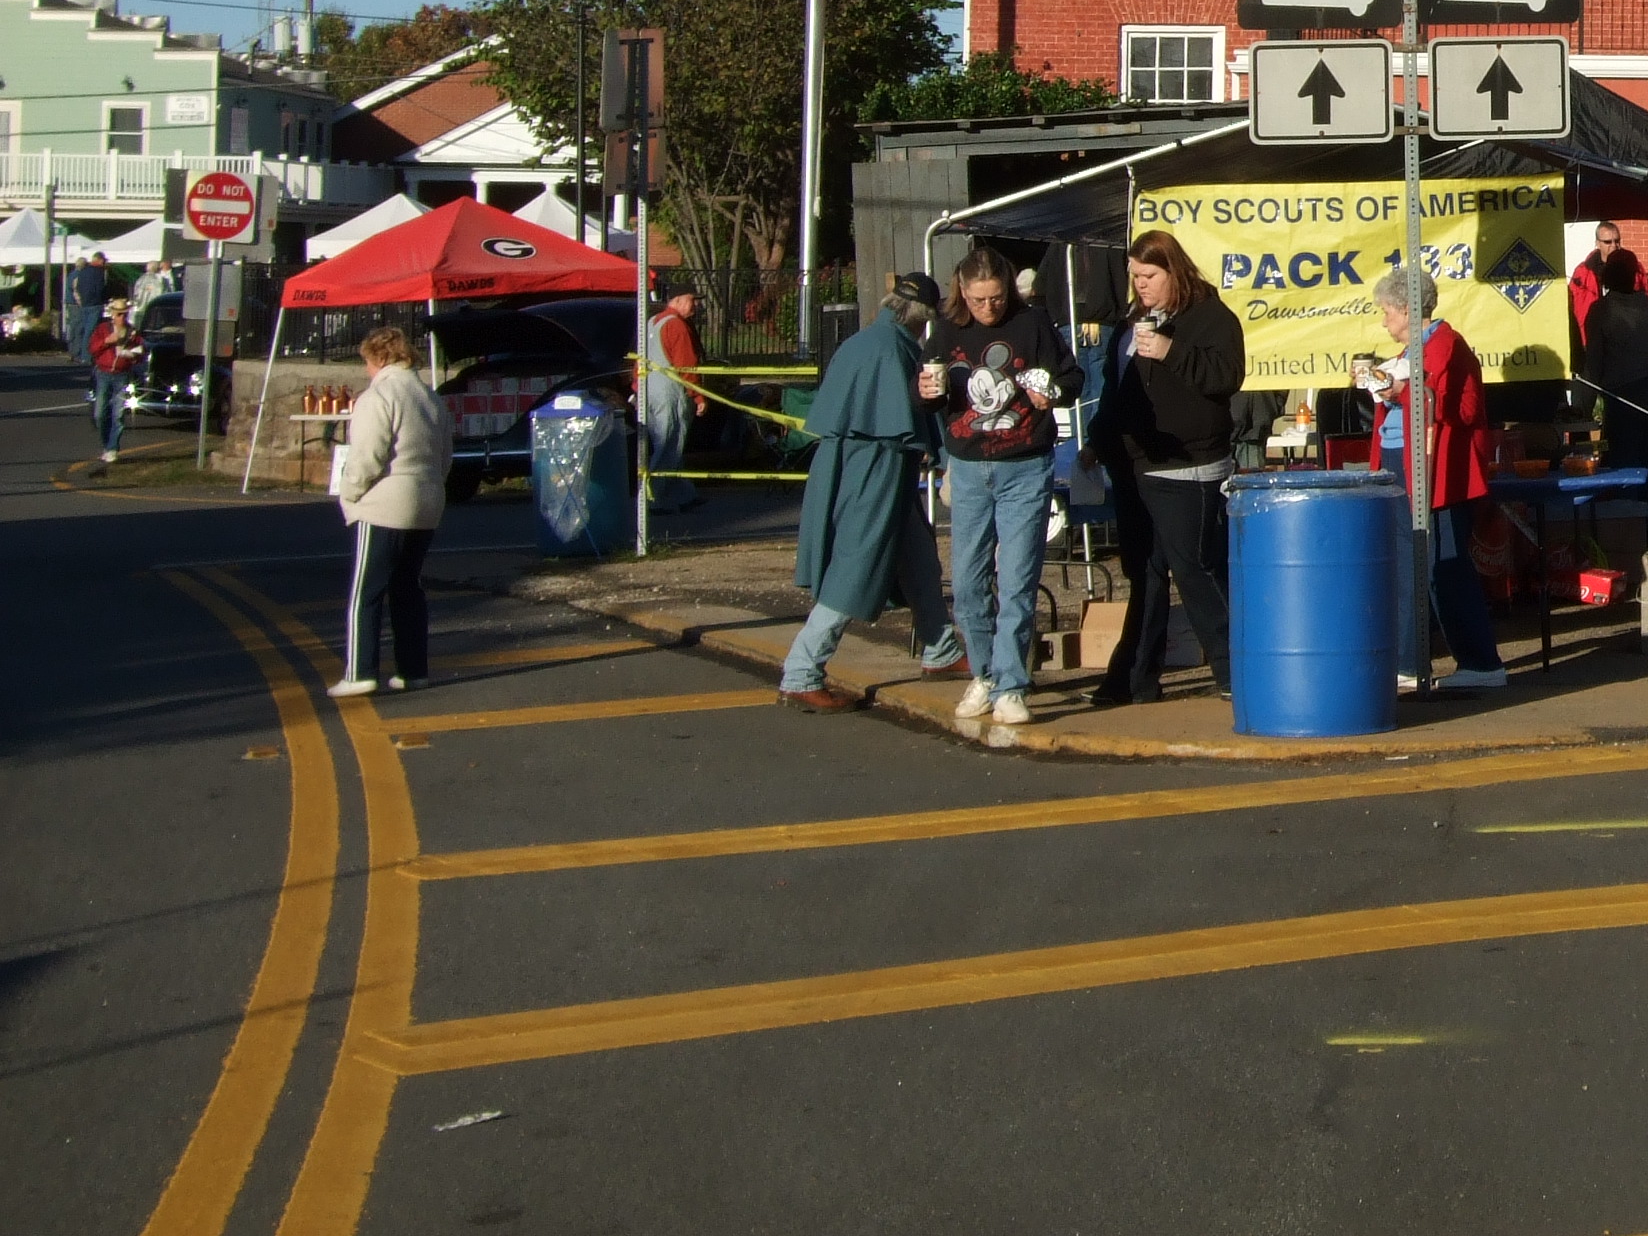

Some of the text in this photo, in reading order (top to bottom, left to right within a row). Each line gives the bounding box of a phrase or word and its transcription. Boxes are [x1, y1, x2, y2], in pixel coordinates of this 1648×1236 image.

[196, 183, 246, 197] DO NOT
[199, 214, 239, 228] ENTER
[1138, 197, 1203, 224] BOY
[1212, 196, 1345, 224] SCOUTS
[1355, 195, 1400, 222] OF
[1221, 250, 1365, 290] PACK
[1471, 344, 1538, 368] hurch
